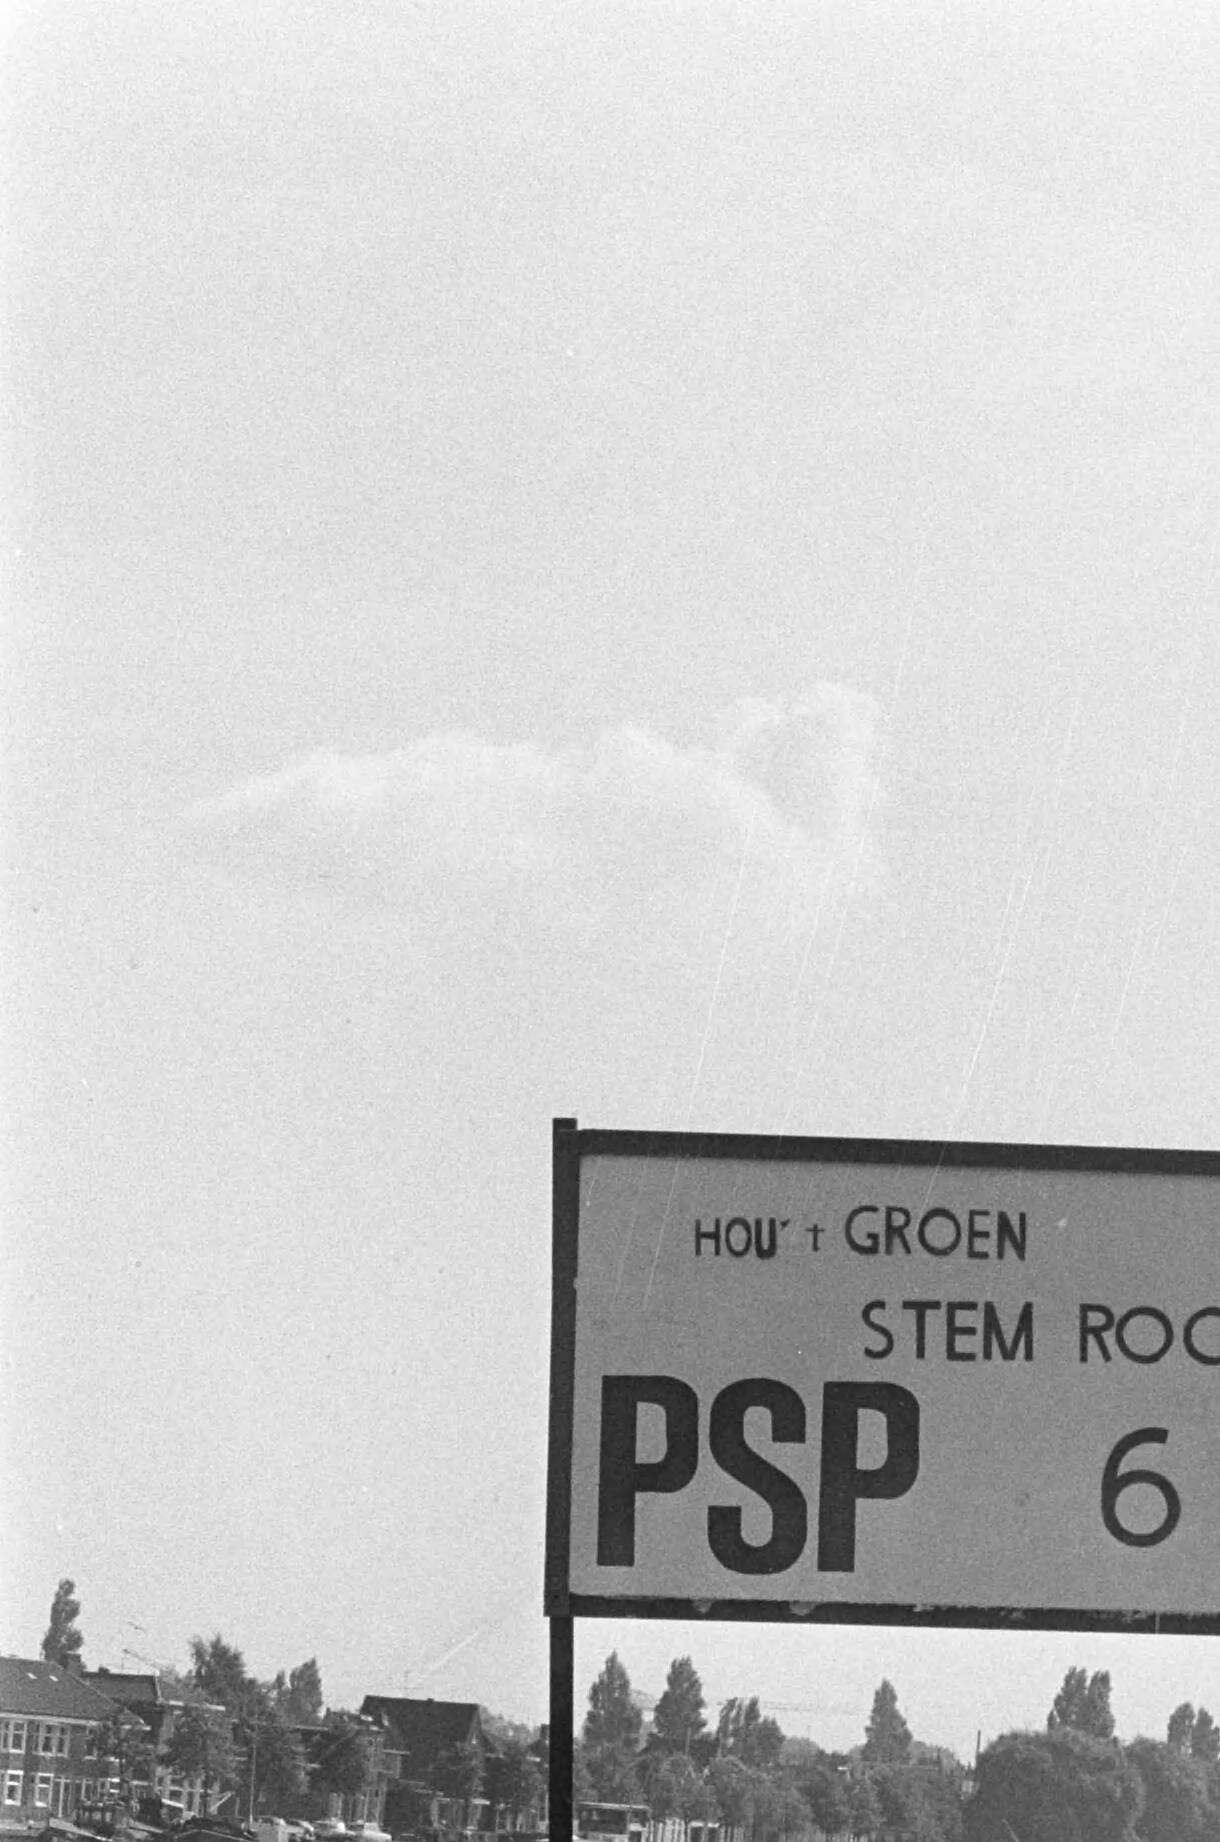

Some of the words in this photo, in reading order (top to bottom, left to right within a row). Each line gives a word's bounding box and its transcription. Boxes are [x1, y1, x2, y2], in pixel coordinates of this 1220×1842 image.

[844, 1205, 1027, 1261] GROEN
[862, 1299, 1034, 1362] STEM
[597, 1374, 921, 1575] PSP
[1100, 1426, 1182, 1548] 6
